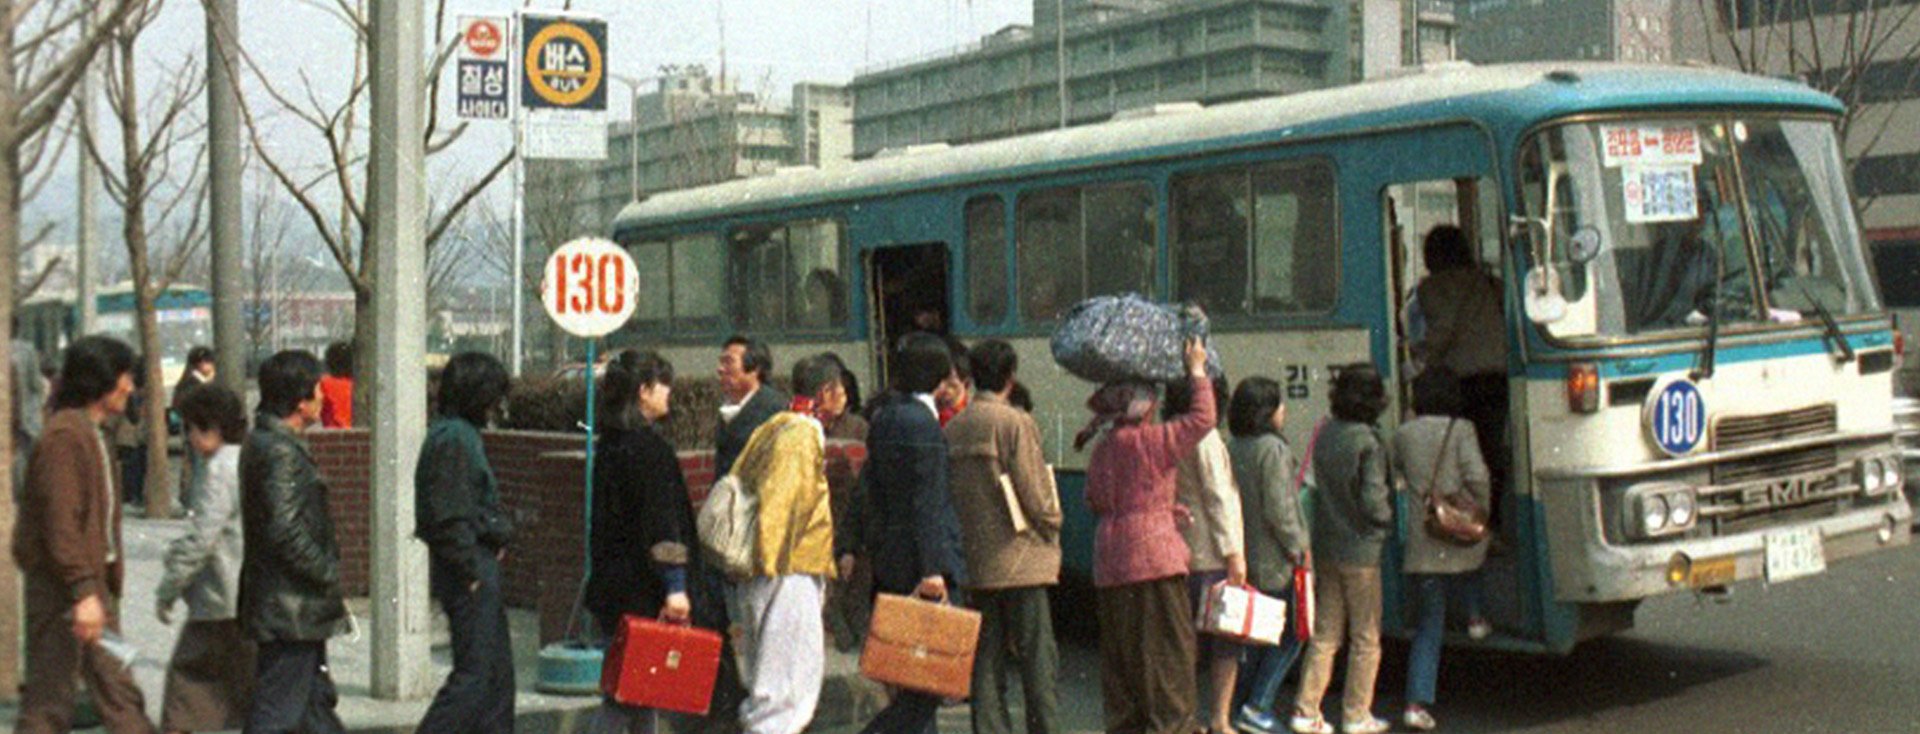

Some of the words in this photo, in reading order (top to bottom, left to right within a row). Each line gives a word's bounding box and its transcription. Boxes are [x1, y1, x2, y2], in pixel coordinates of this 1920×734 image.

[544, 42, 586, 71] 버스
[461, 65, 504, 96] 칠성
[556, 252, 625, 314] 130
[1662, 389, 1698, 444] 130
